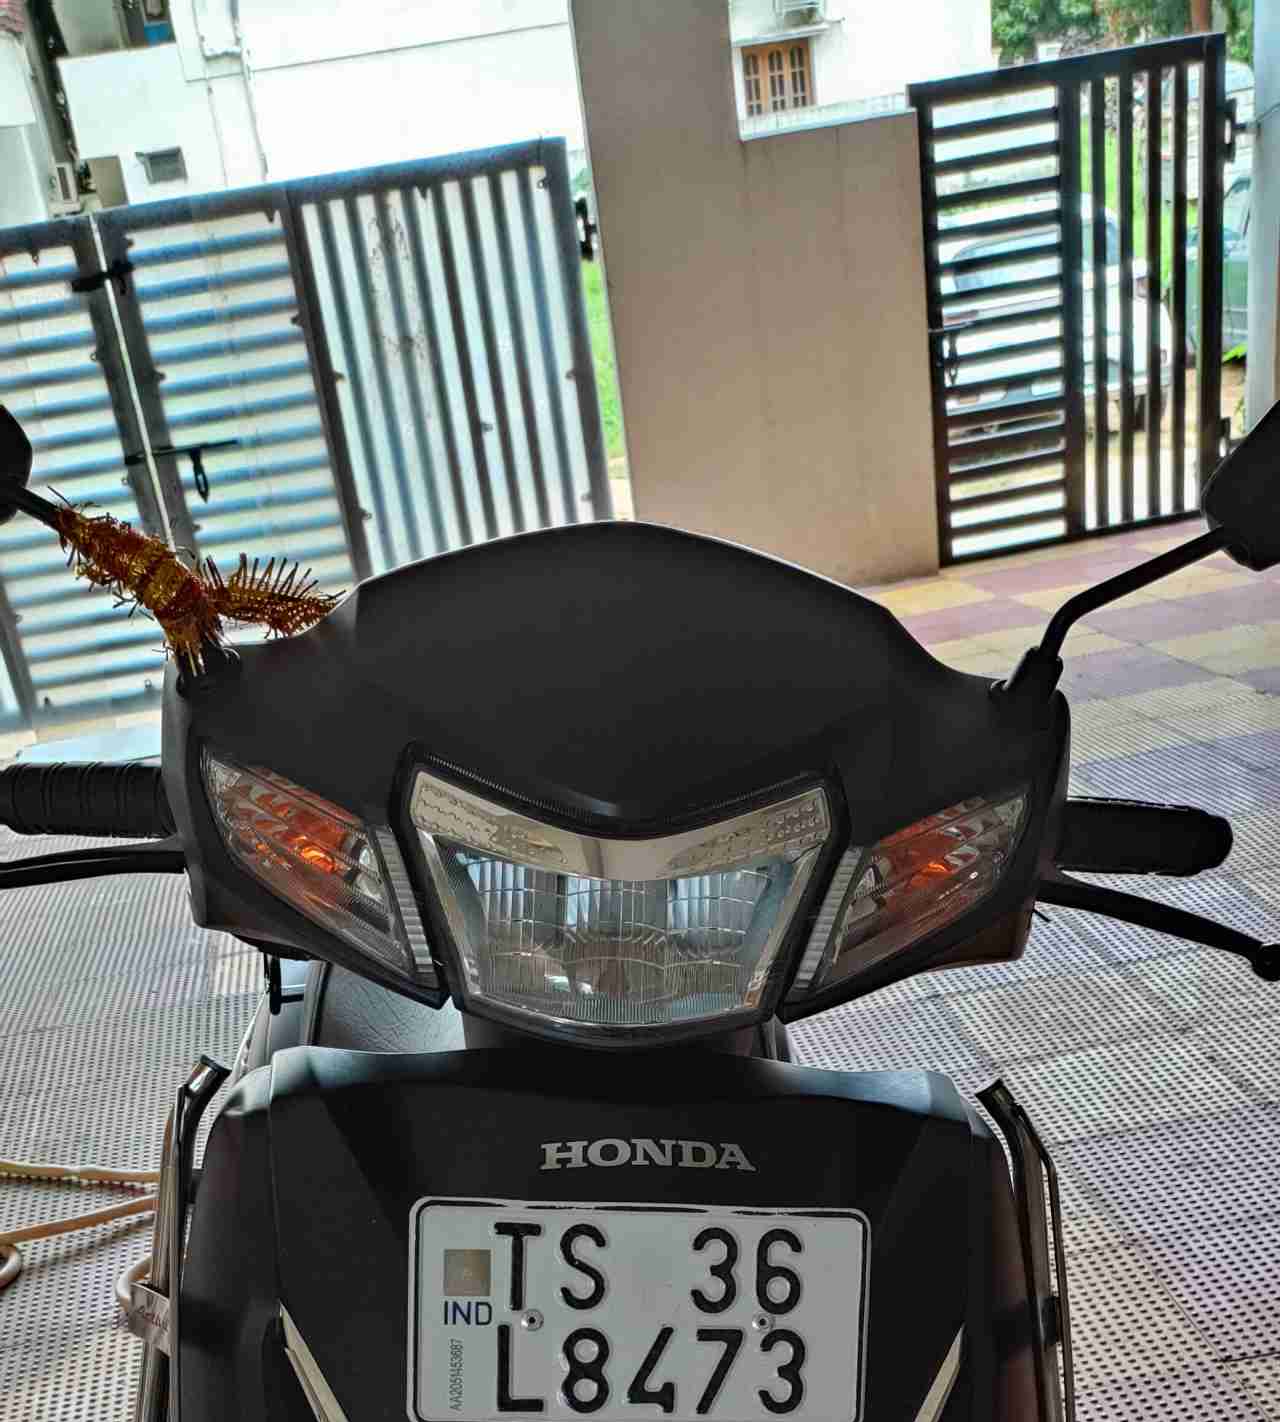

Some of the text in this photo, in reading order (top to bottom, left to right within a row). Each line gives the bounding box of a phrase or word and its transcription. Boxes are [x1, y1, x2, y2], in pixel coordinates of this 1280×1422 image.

[540, 1138, 756, 1171] HONDA
[494, 1222, 803, 1314] TS 36
[443, 1302, 493, 1325] IND
[497, 1324, 806, 1414] L8473
